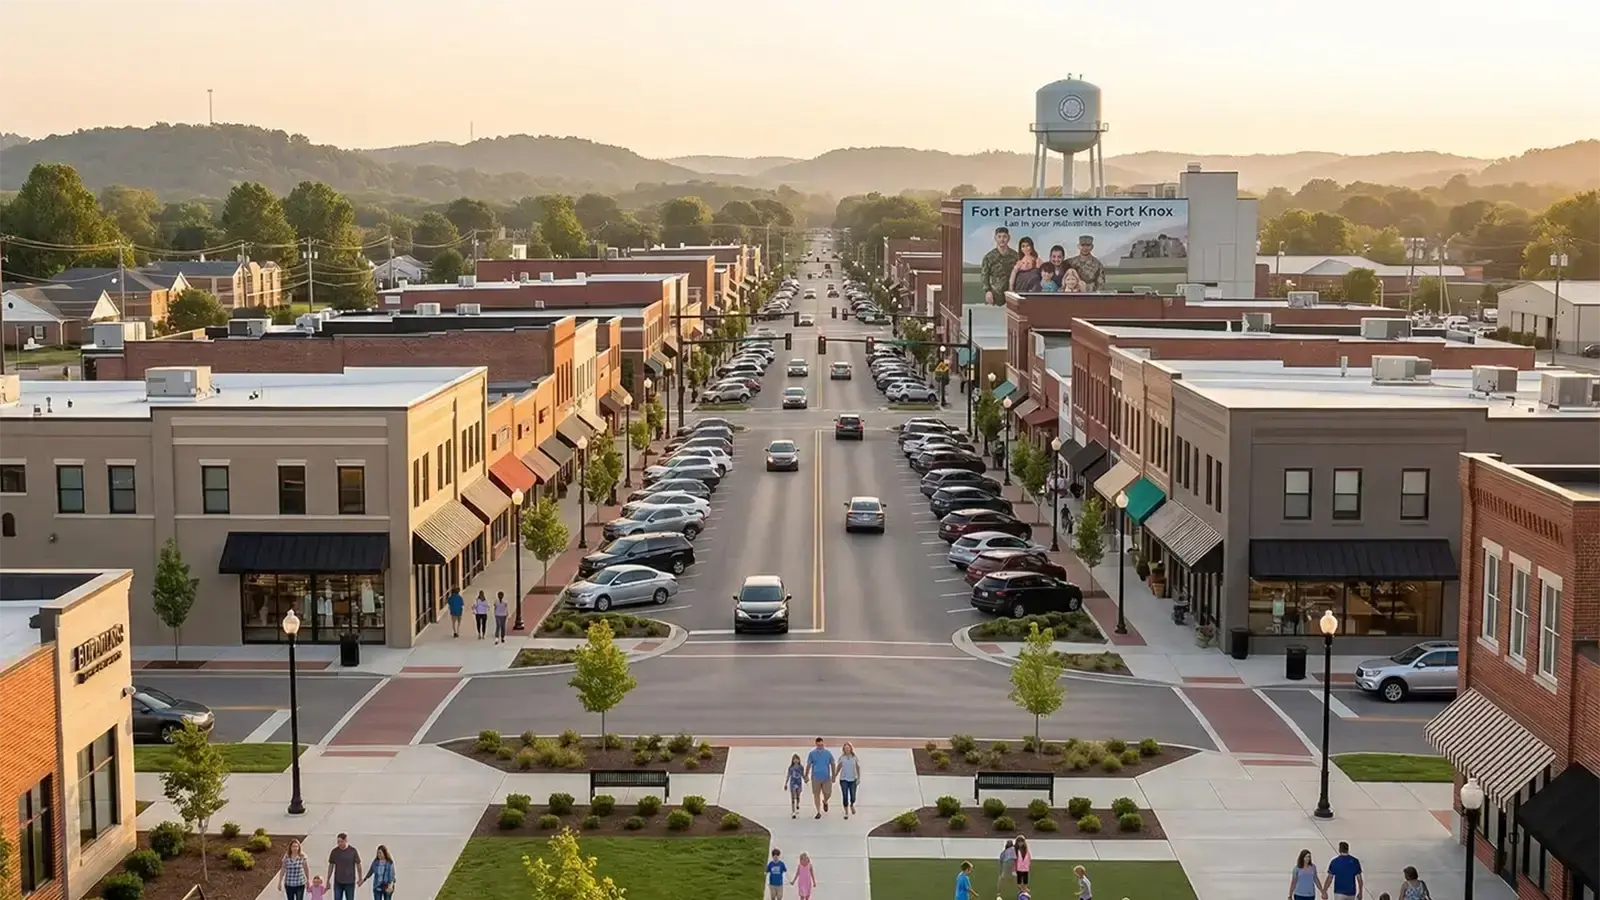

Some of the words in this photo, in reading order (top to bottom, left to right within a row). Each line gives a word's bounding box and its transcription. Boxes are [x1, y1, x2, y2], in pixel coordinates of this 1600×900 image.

[971, 205, 1000, 217] Fort
[1004, 205, 1069, 217] Partnerse
[1072, 205, 1102, 217] with
[1106, 205, 1135, 217] Fort
[1138, 205, 1174, 217] Knox
[1031, 221, 1050, 229] your
[1104, 220, 1141, 229] together
